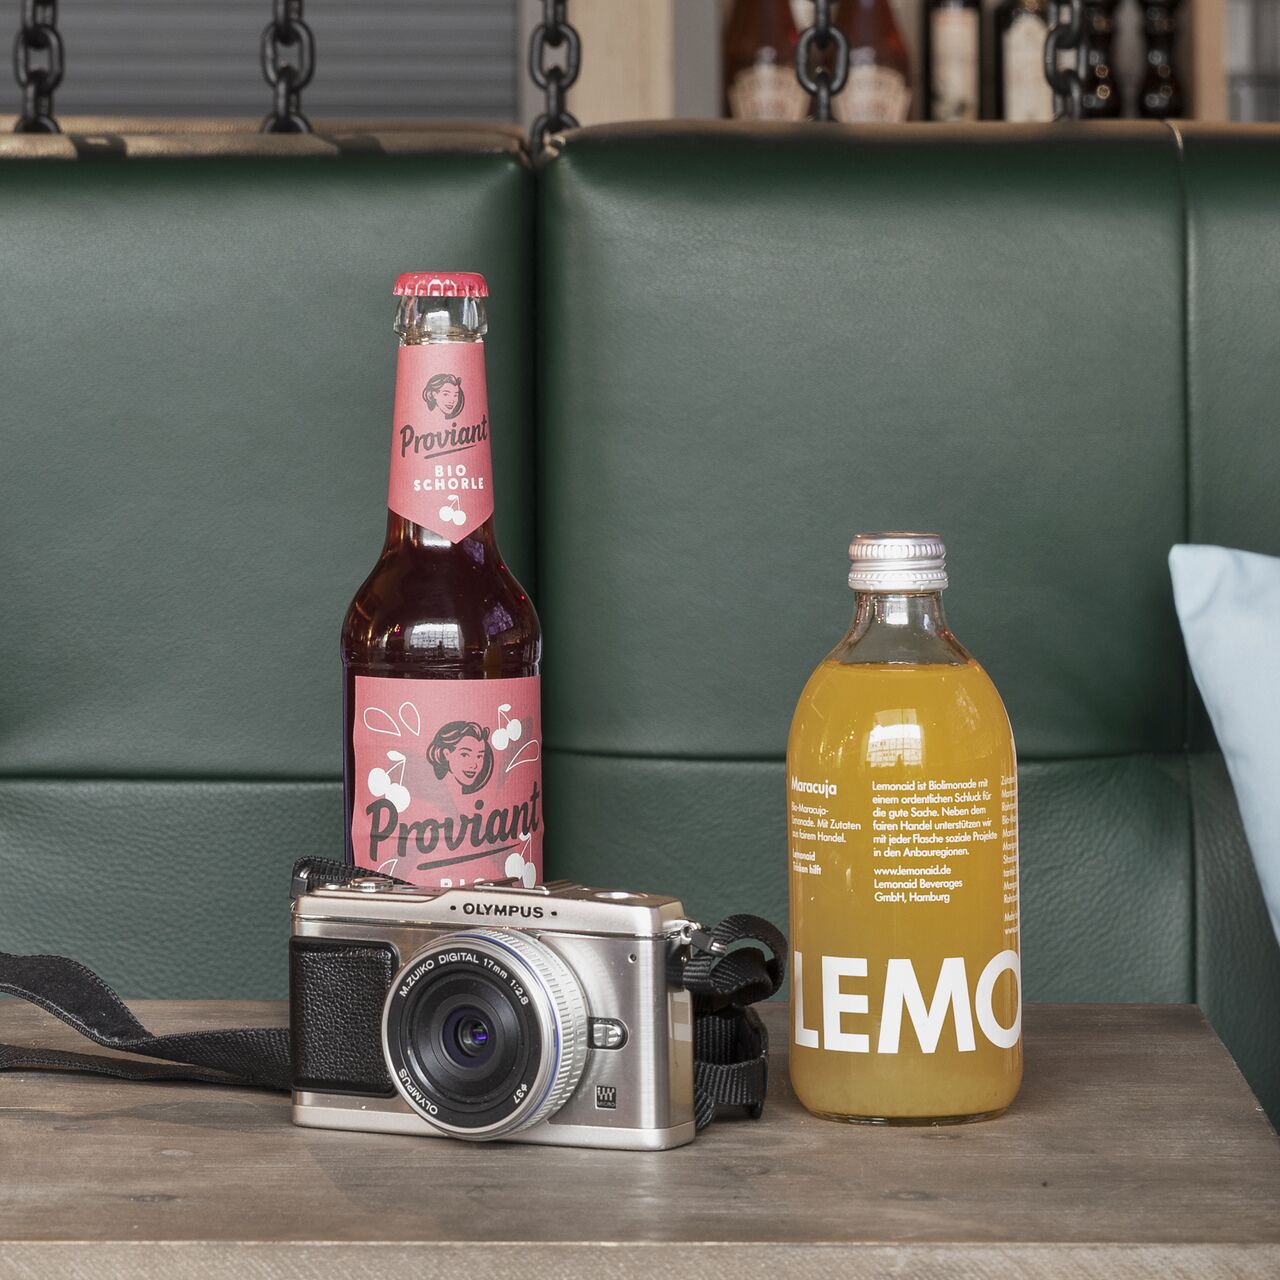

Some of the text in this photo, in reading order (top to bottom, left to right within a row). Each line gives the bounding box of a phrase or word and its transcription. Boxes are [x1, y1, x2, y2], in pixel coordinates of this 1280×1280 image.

[400, 413, 488, 458] Proviant
[435, 464, 467, 477] BIO
[413, 477, 484, 491] SCHORLE
[792, 775, 837, 798] Maracuja
[872, 780, 915, 791] Lemonaid
[917, 781, 926, 791] ist
[928, 779, 977, 790] Biolimonade
[978, 778, 988, 788] mit
[872, 790, 992, 804] einem ordentlichen Schluck für
[872, 805, 986, 819] die gute Sache. Neben dem
[366, 781, 540, 861] Proviant
[817, 818, 828, 828] Mit
[830, 819, 861, 830] Zutaten
[872, 817, 992, 831] fairen Handel unterstützen wir
[817, 831, 846, 843] Handel.
[873, 830, 998, 846] mit jeder Flasche soziale Projekte
[873, 847, 969, 858] in den Anbauregionen.
[873, 865, 952, 875] www.lemonaid.de
[874, 879, 963, 890] Lemonaid Beverages
[874, 891, 950, 904] GmbH, Hamburg
[463, 903, 544, 919] OLYMPUS
[399, 952, 529, 1005] M.ZUIKO DIGITAL 17mm 1:2.8
[399, 1068, 439, 1115] OLYMPUS
